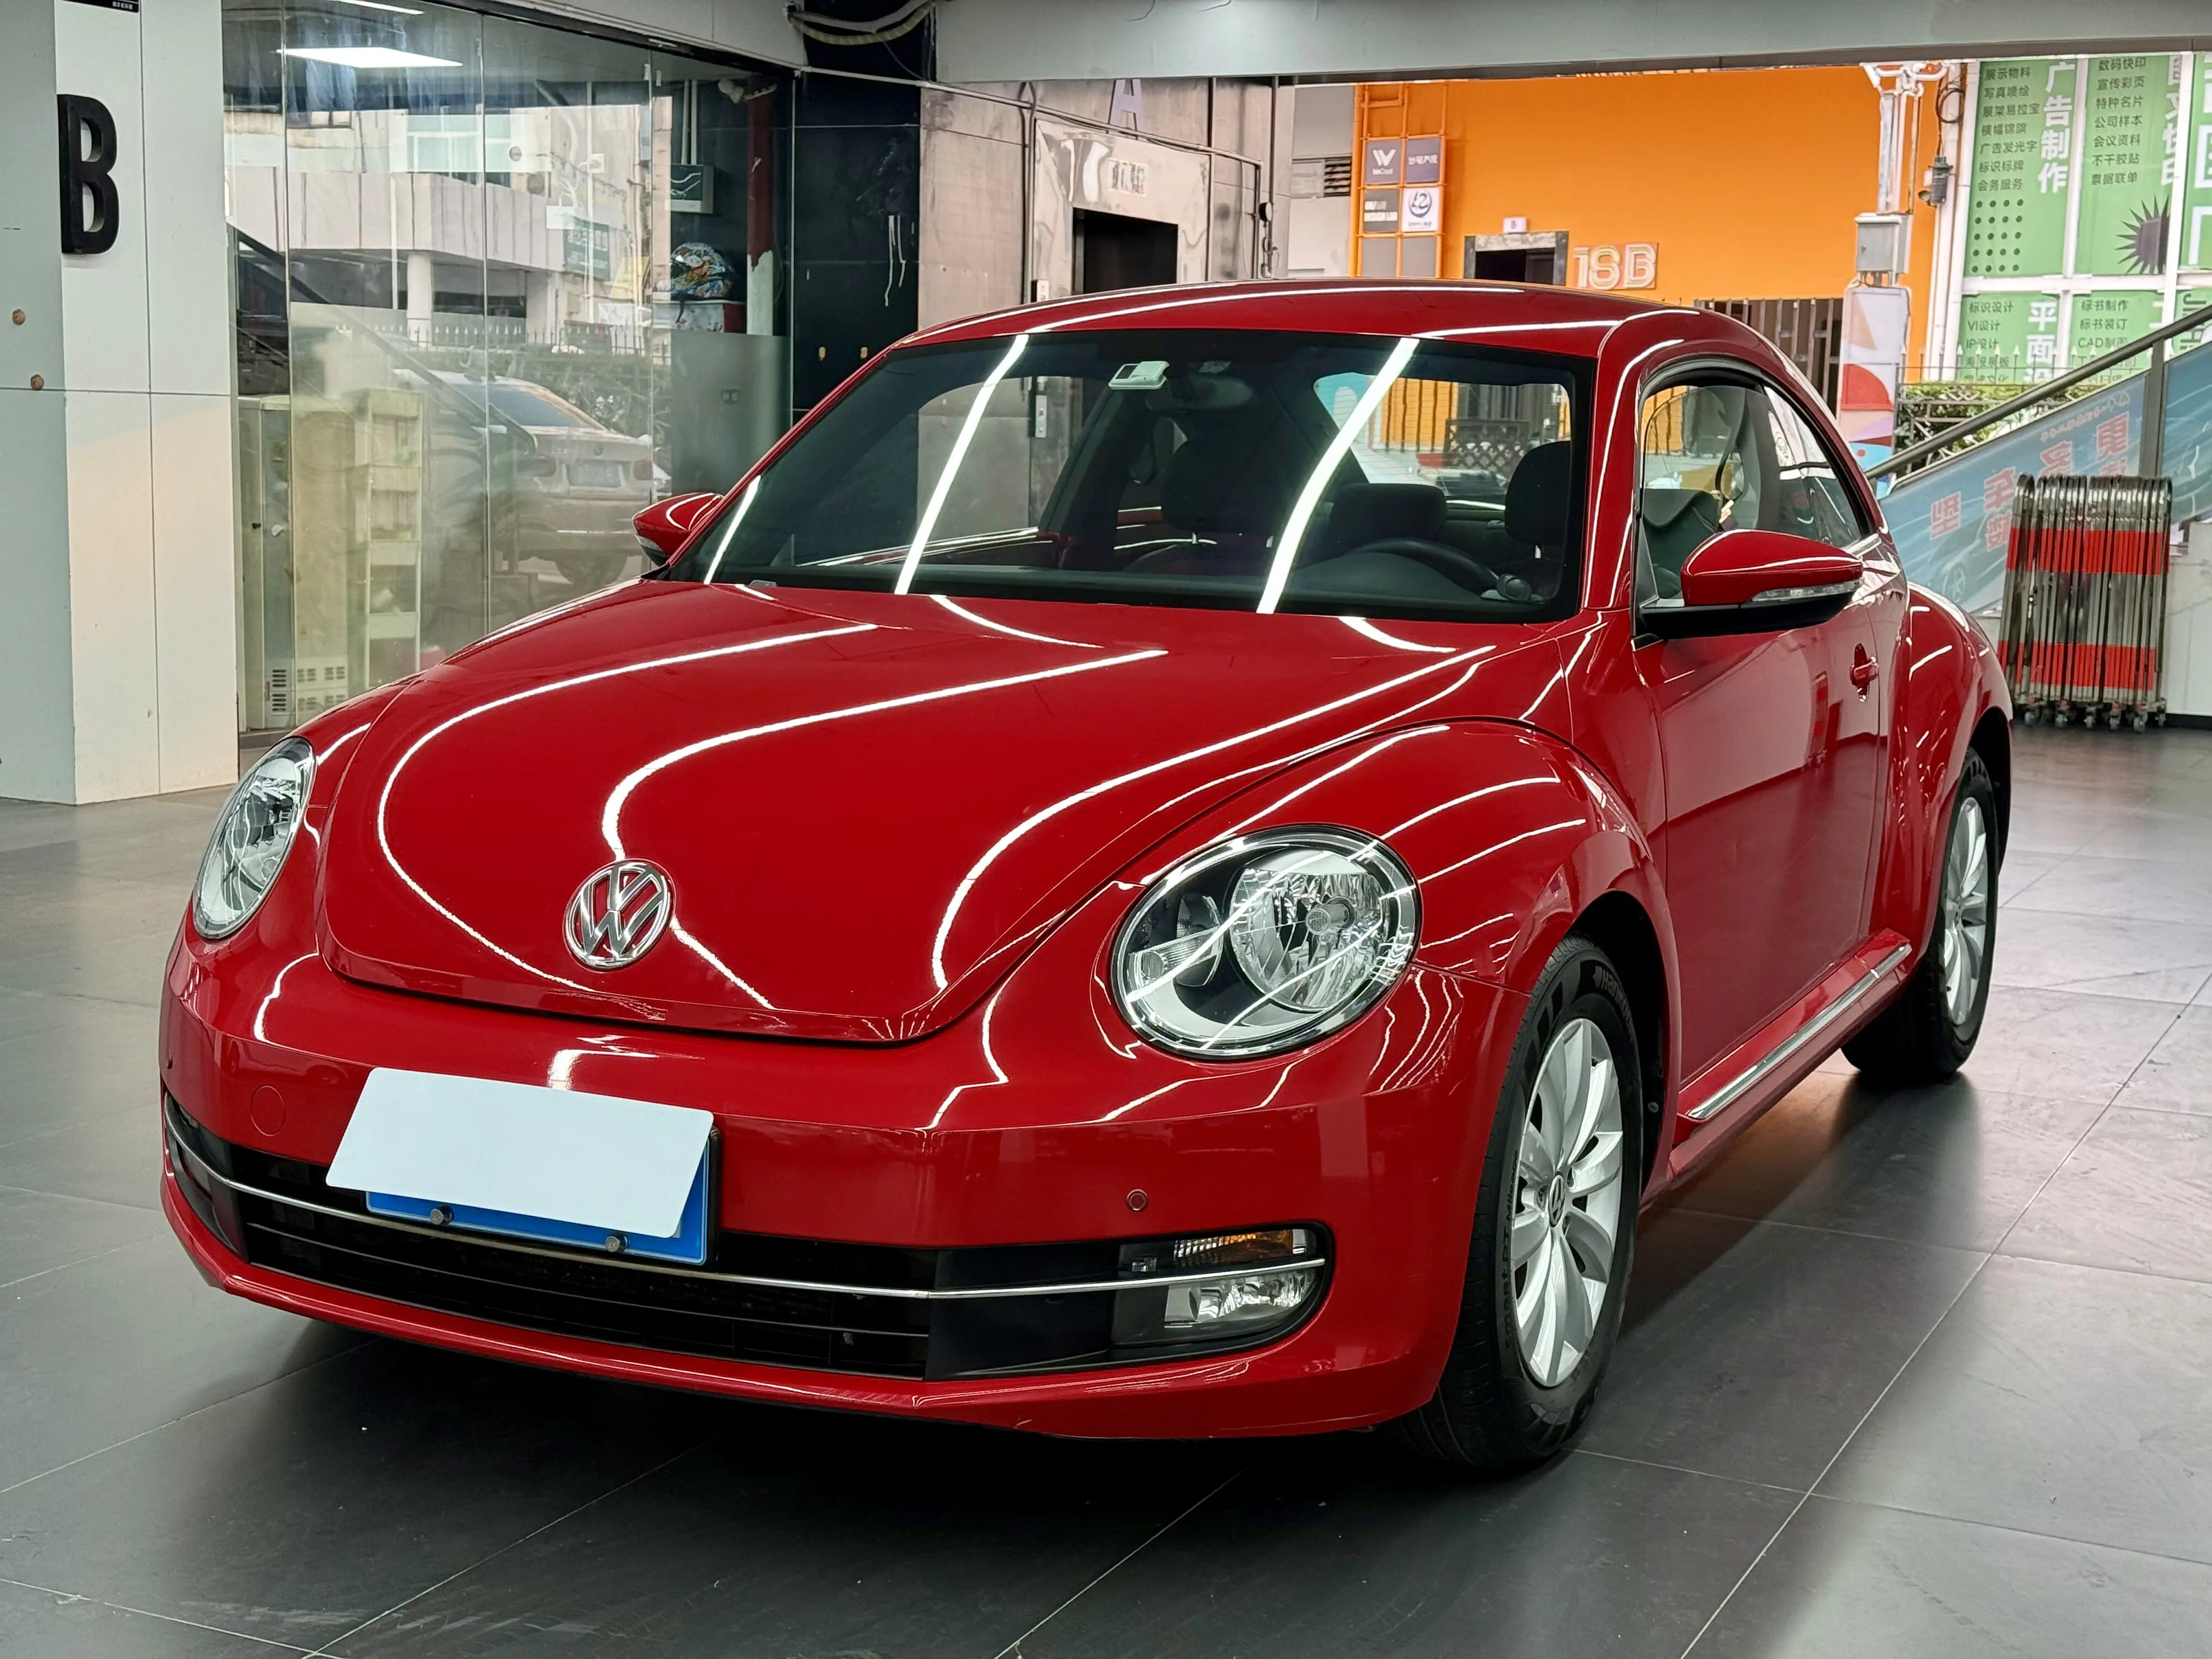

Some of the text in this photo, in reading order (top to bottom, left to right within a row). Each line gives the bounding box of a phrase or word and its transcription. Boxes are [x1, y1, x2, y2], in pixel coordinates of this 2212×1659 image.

[2098, 57, 2146, 71] 数码快印
[2097, 76, 2145, 91] 宣传彩页
[1984, 84, 2029, 99] 写真喷绘
[2096, 95, 2144, 109] 特种名片
[2038, 61, 2075, 194] 广告制作
[2095, 114, 2142, 128] 公司样本
[1980, 140, 2037, 155] 广告发光字
[2094, 133, 2141, 148] 会议资料
[1979, 160, 2024, 173] 标识标牌
[2092, 153, 2140, 166] 不干胶贴
[57, 94, 119, 255] B
[2091, 172, 2137, 185] 票据联单
[1573, 244, 1656, 290] 18B
[1970, 301, 2014, 313] 标识设计
[2081, 300, 2129, 312] 标书制作
[1967, 320, 2001, 331] VI设计
[2080, 318, 2128, 330] 标书装订
[1966, 338, 1999, 349] IP设计
